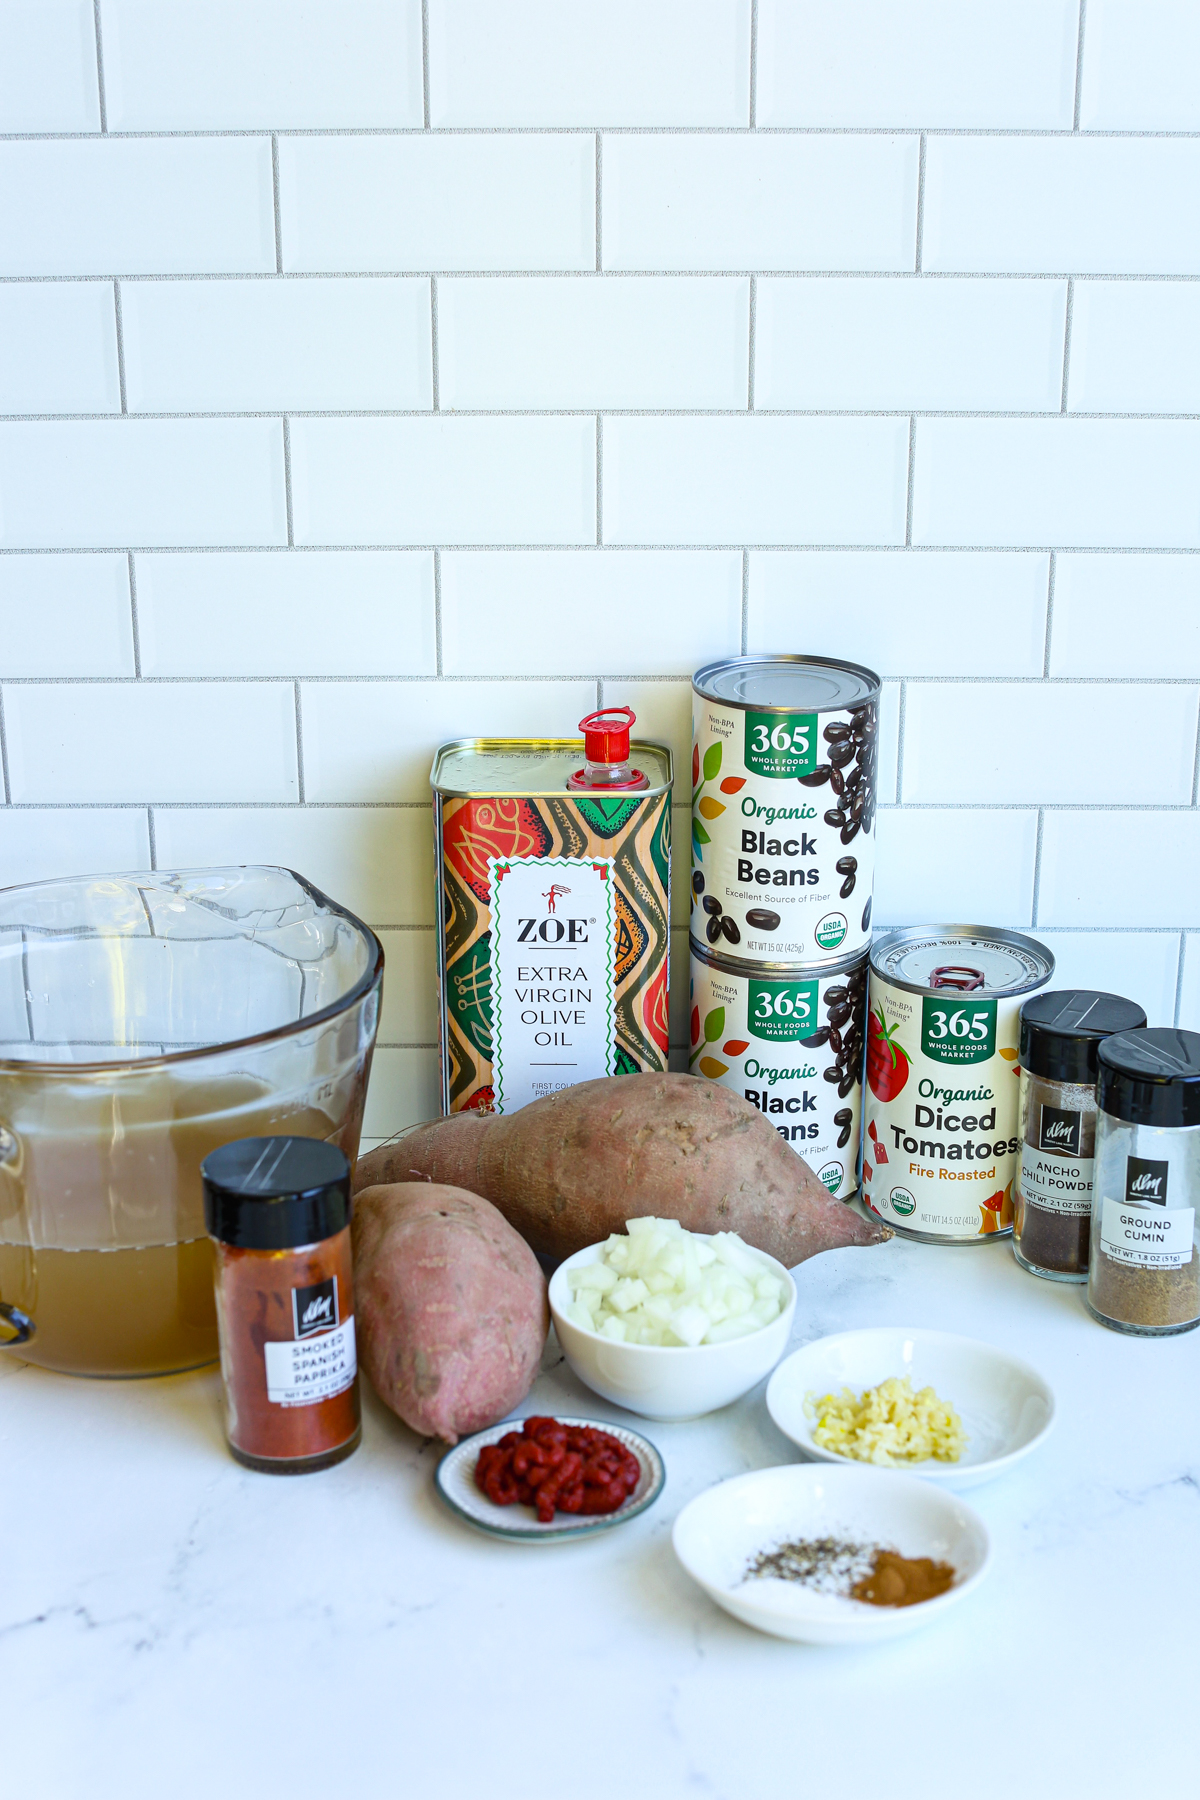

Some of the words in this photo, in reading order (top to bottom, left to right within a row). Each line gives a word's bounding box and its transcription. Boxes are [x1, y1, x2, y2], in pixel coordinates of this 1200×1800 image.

[708, 714, 735, 729] Non-BPA
[751, 722, 810, 755] 365
[751, 756, 779, 765] WHOLE
[781, 757, 809, 765] FOODS
[763, 765, 797, 773] MARKET
[741, 796, 818, 825] Organic
[741, 829, 818, 856] Black
[737, 858, 820, 886] Beans
[725, 887, 762, 901] Excellent
[764, 894, 796, 903] Source
[798, 894, 808, 903] of
[809, 893, 831, 902] Fiber
[823, 920, 842, 931] USDA
[819, 930, 844, 942] ORGANIC
[747, 940, 758, 951] NET
[758, 942, 767, 951] WT
[768, 943, 775, 952] 15
[776, 943, 784, 952] OZ
[784, 942, 805, 954] (425g)
[517, 966, 589, 981] EXTRA
[514, 988, 592, 1003] VIRGIN
[710, 980, 738, 996] Non-BPA
[754, 989, 811, 1019] 365
[884, 995, 914, 1013] Non-BPA
[520, 1010, 586, 1025] OLIVE
[754, 1021, 782, 1029] WHOLE
[784, 1021, 811, 1029] FOODS
[928, 1009, 989, 1041] 365
[534, 1031, 573, 1046] OIL
[928, 1041, 957, 1051] WHOLE
[960, 1043, 988, 1051] FOODS
[744, 1058, 818, 1086] Organic
[531, 1082, 553, 1090] FIRST
[918, 1078, 995, 1107] Organic
[744, 1088, 818, 1114] Black
[914, 1103, 997, 1132] Diced
[775, 1122, 819, 1141] ans
[890, 1123, 1018, 1160] Tomatoes
[799, 1147, 808, 1156] of
[809, 1144, 830, 1155] Fiber
[822, 1168, 839, 1180] USDA
[909, 1162, 935, 1179] Fire
[939, 1166, 996, 1181] Roasted
[1036, 1161, 1080, 1178] ANCHO
[1022, 1166, 1045, 1185] CHILI
[1048, 1178, 1093, 1191] POWDE
[893, 1199, 912, 1211] ORGANIC
[895, 1192, 910, 1203] USDA
[1026, 1190, 1037, 1200] NET
[1050, 1199, 1060, 1207] 2.1
[1073, 1202, 1092, 1210] (59g)
[921, 1213, 931, 1223] NET
[931, 1215, 941, 1224] WT
[941, 1215, 954, 1225] 14.5
[954, 1216, 962, 1225] OZ
[1119, 1215, 1172, 1230] GROUND
[1124, 1229, 1165, 1242] CUMIN
[1109, 1245, 1122, 1255] NET
[292, 1333, 344, 1358] SMOKED
[292, 1346, 345, 1372] SPANISH
[293, 1361, 346, 1384] PAPRIKA
